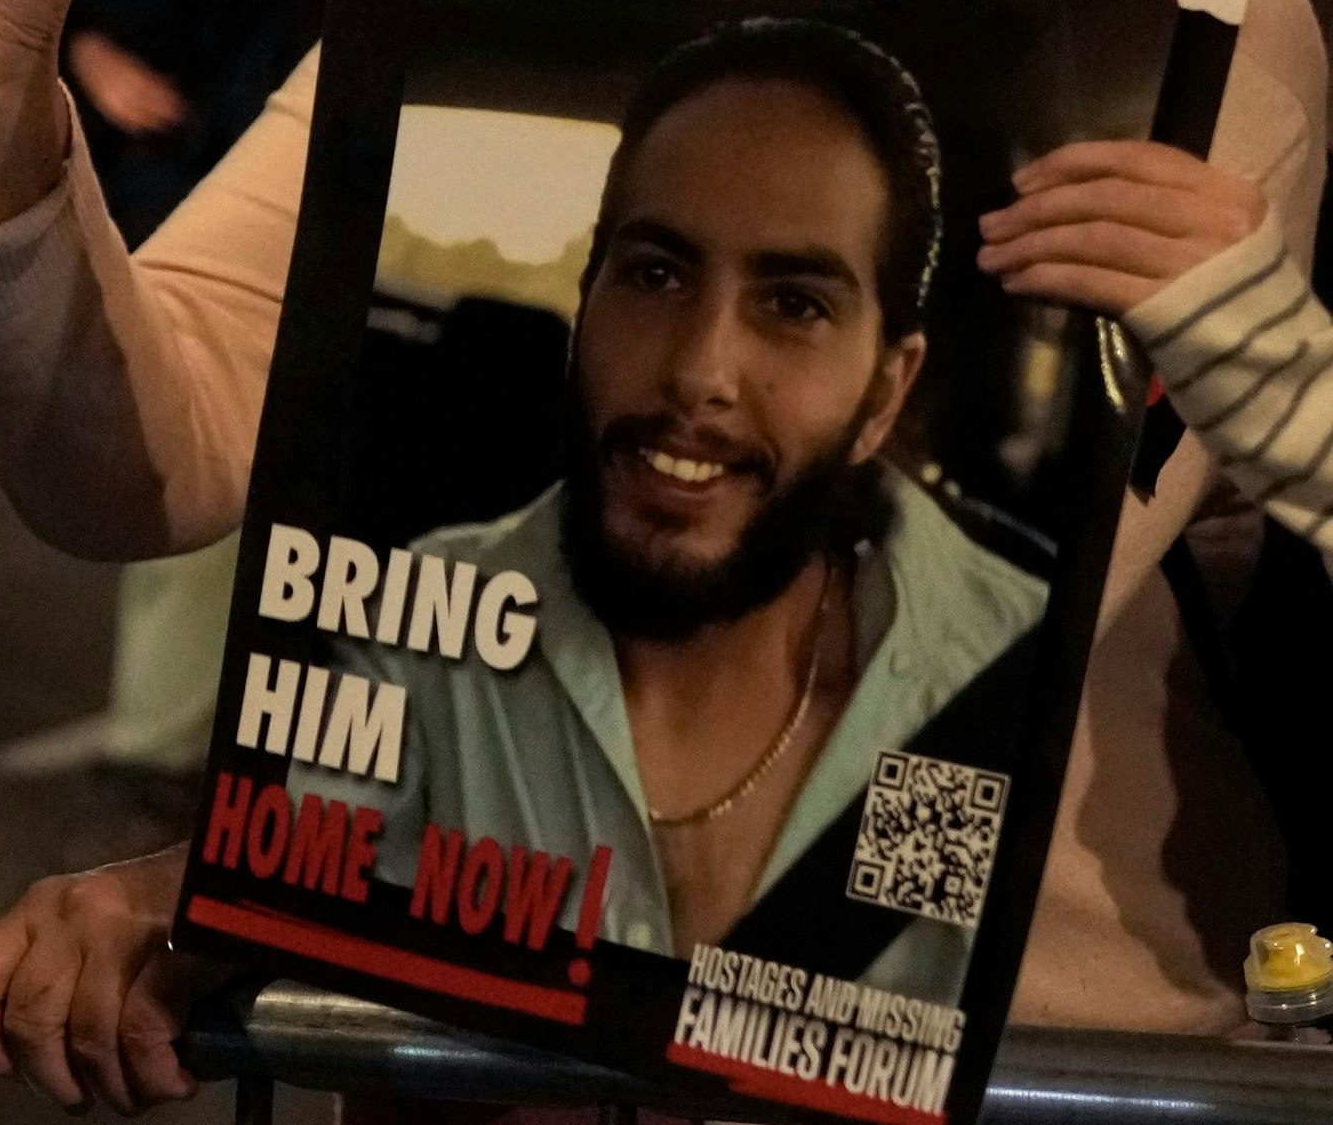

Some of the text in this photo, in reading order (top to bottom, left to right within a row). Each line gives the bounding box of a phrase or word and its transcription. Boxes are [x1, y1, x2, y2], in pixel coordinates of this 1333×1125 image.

[258, 523, 539, 671] BRING
[236, 652, 407, 783] HIM
[201, 771, 384, 905] HOME
[673, 986, 957, 1117] FAMILIES FORUM
[688, 943, 967, 1053] HOSTAGES AND MISSING
